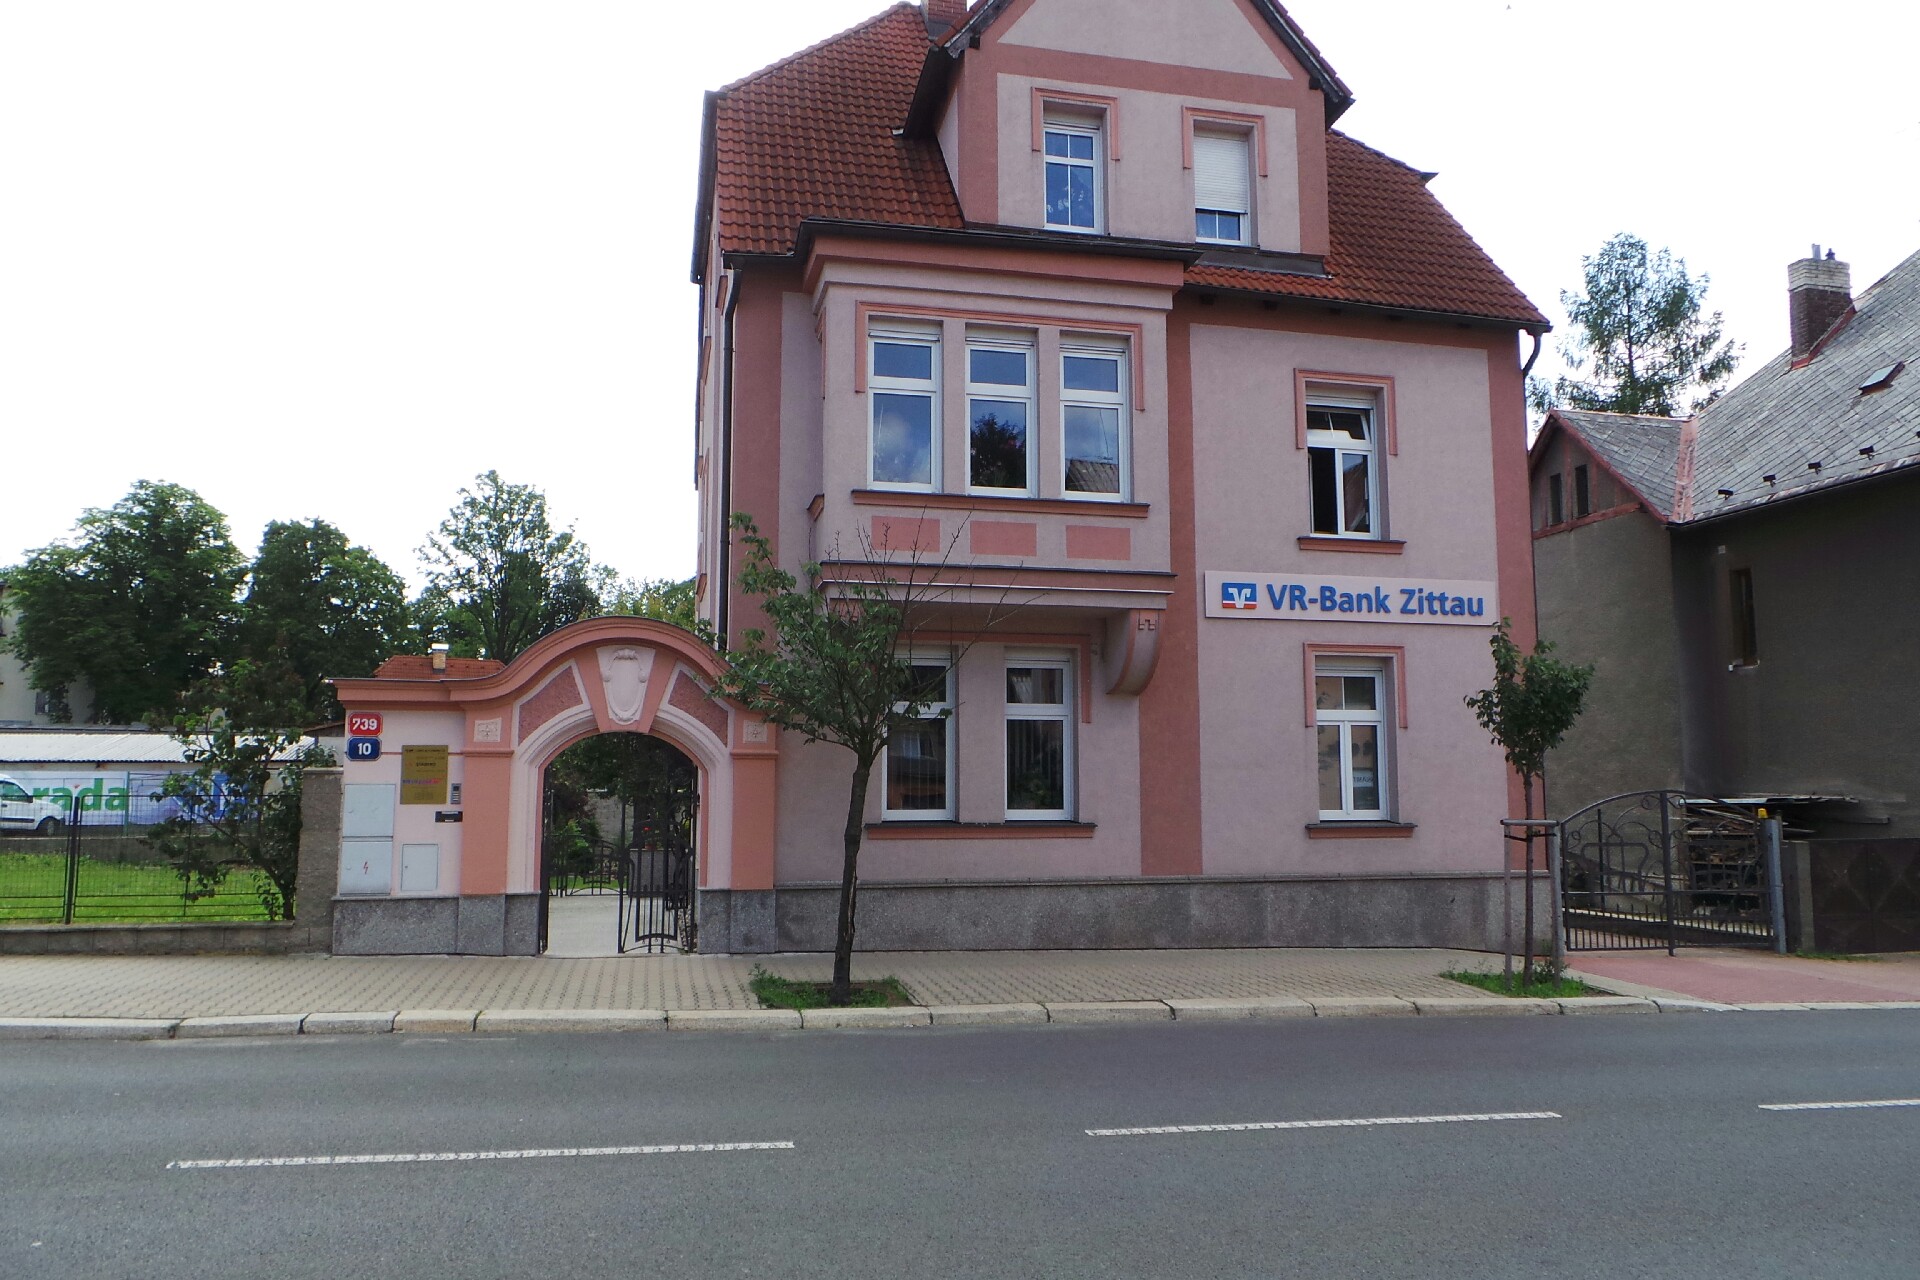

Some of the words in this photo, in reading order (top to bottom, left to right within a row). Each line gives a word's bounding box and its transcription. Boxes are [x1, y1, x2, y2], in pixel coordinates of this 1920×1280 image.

[1266, 583, 1392, 614] VR-Bank
[1399, 587, 1484, 617] Zittau
[352, 718, 378, 731] 739
[357, 742, 372, 756] 10
